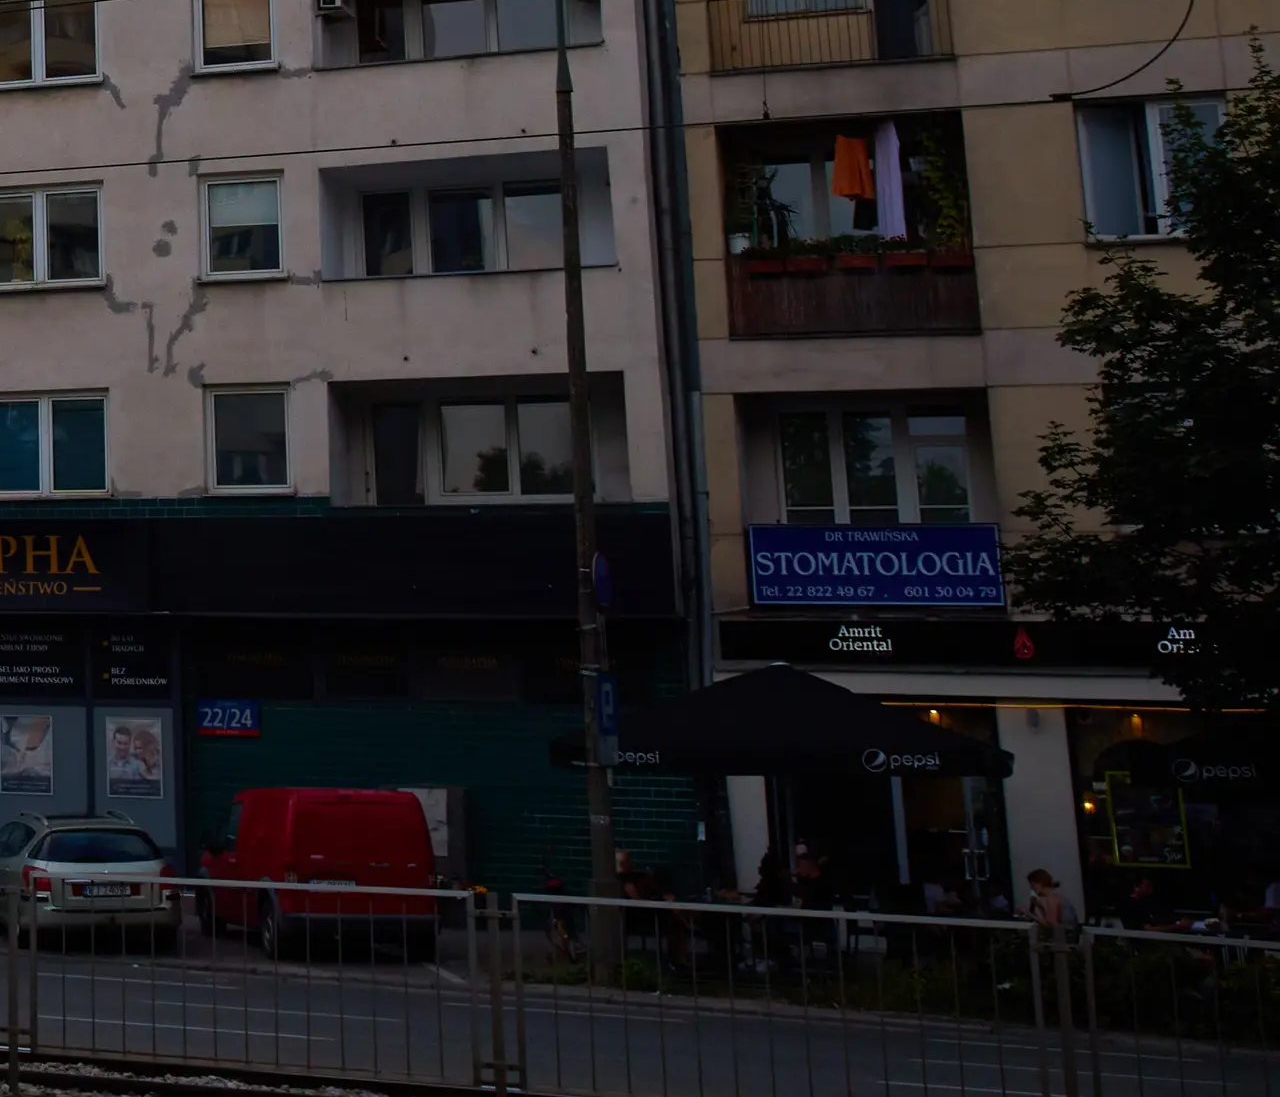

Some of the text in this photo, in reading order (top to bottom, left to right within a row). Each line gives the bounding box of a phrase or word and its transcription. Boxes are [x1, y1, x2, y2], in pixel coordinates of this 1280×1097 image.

[824, 528, 919, 542] DR TRAWIŃSKA
[756, 551, 996, 576] STOMATOLOGIA
[760, 586, 875, 597] Tel. 22 822 49 67
[904, 586, 930, 597] 601
[955, 586, 974, 597] 04
[978, 586, 996, 597] 79
[838, 624, 882, 637] Amrit
[829, 638, 893, 651] Oriental
[111, 666, 126, 674] BEZ
[31, 676, 75, 685] FINANSOWY
[112, 675, 168, 685] POŚREDNIKÓW
[199, 707, 252, 729] 22/24
[890, 751, 940, 769] pepsi
[1202, 762, 1257, 780] pepsi
